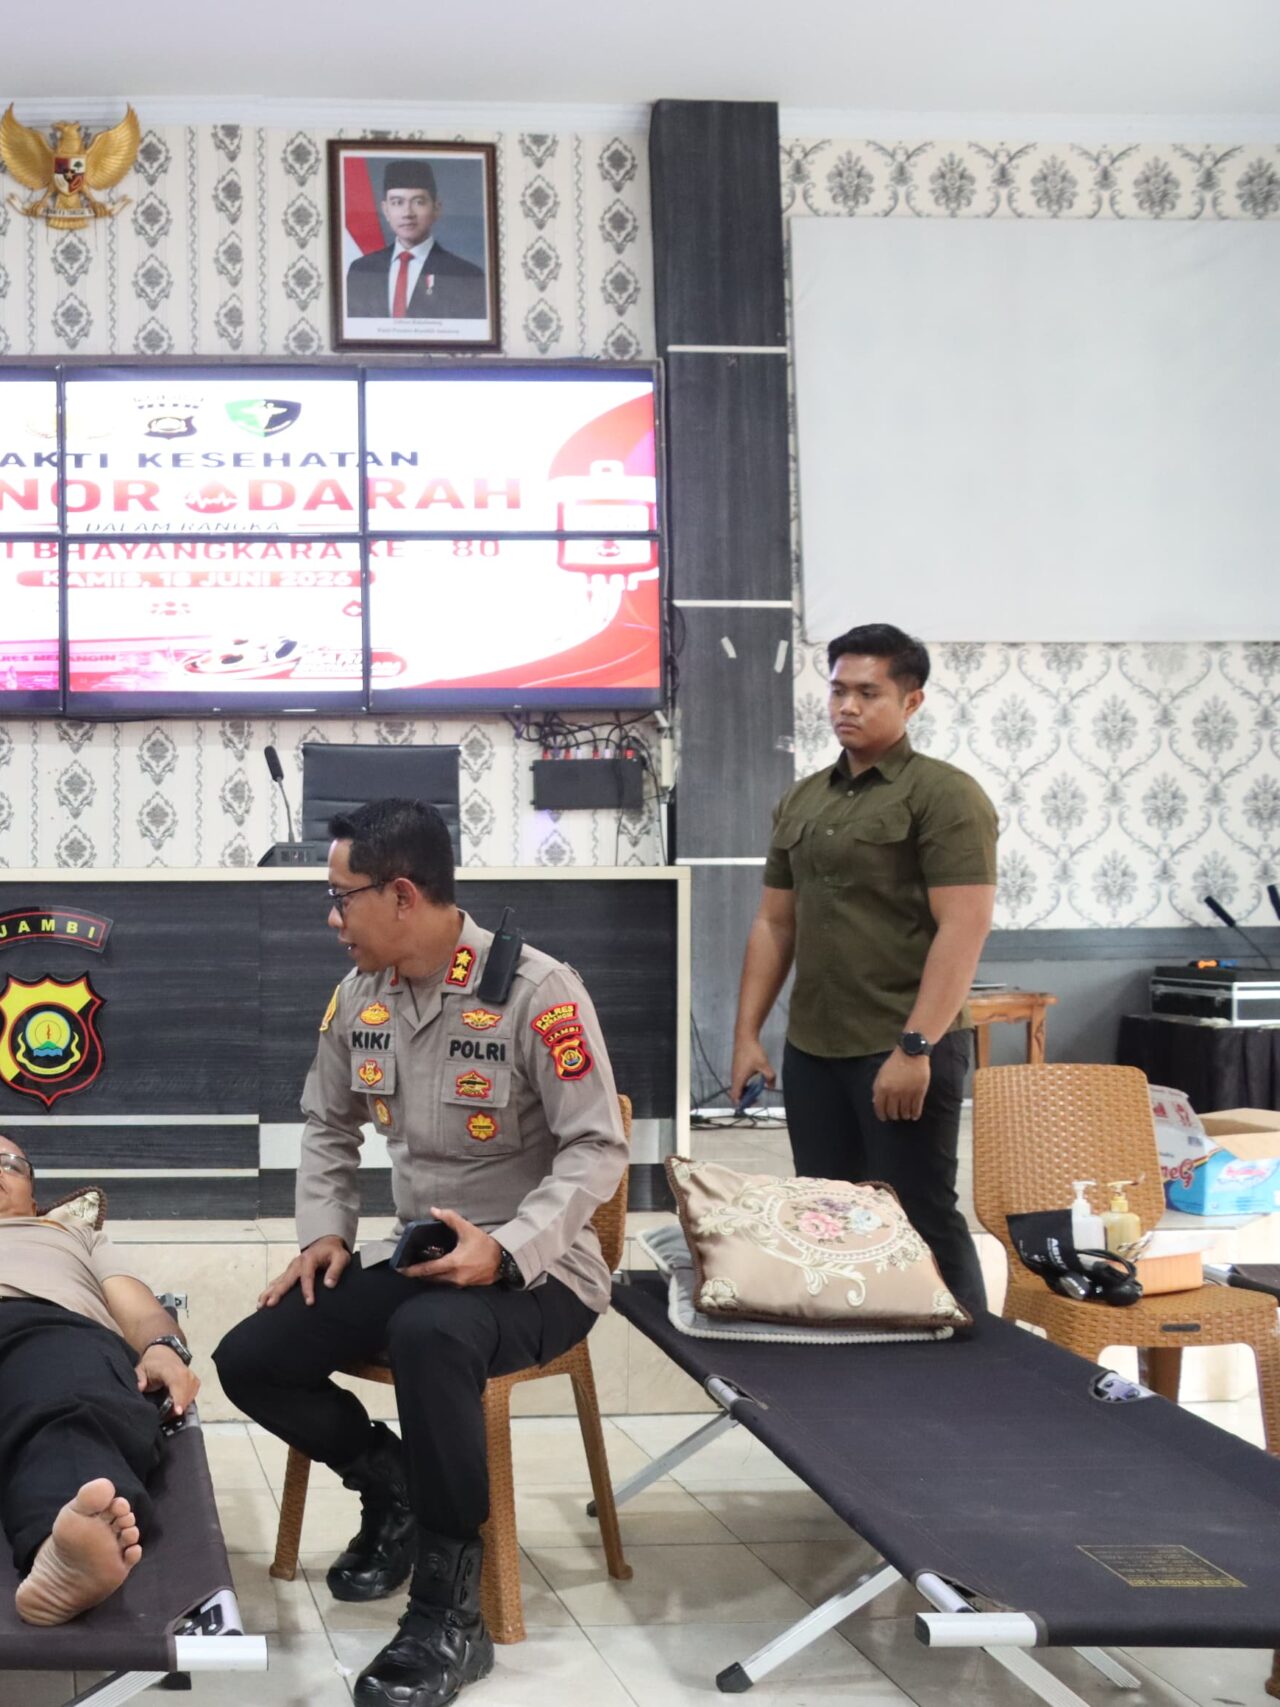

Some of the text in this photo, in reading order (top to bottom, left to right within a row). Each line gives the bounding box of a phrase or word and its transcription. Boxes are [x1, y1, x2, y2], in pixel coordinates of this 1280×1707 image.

[138, 450, 418, 468] KESEHATAN
[248, 476, 521, 512] DARAH
[34, 540, 342, 560] BHAYANGKARA
[452, 540, 500, 558] 80
[42, 571, 150, 588] KAMIS,
[199, 571, 270, 588] JUNI
[280, 571, 352, 587] 2026
[535, 1005, 574, 1026] POLRES
[548, 1026, 579, 1042] JAMBI
[351, 1030, 506, 1062] KIKI POLRI
